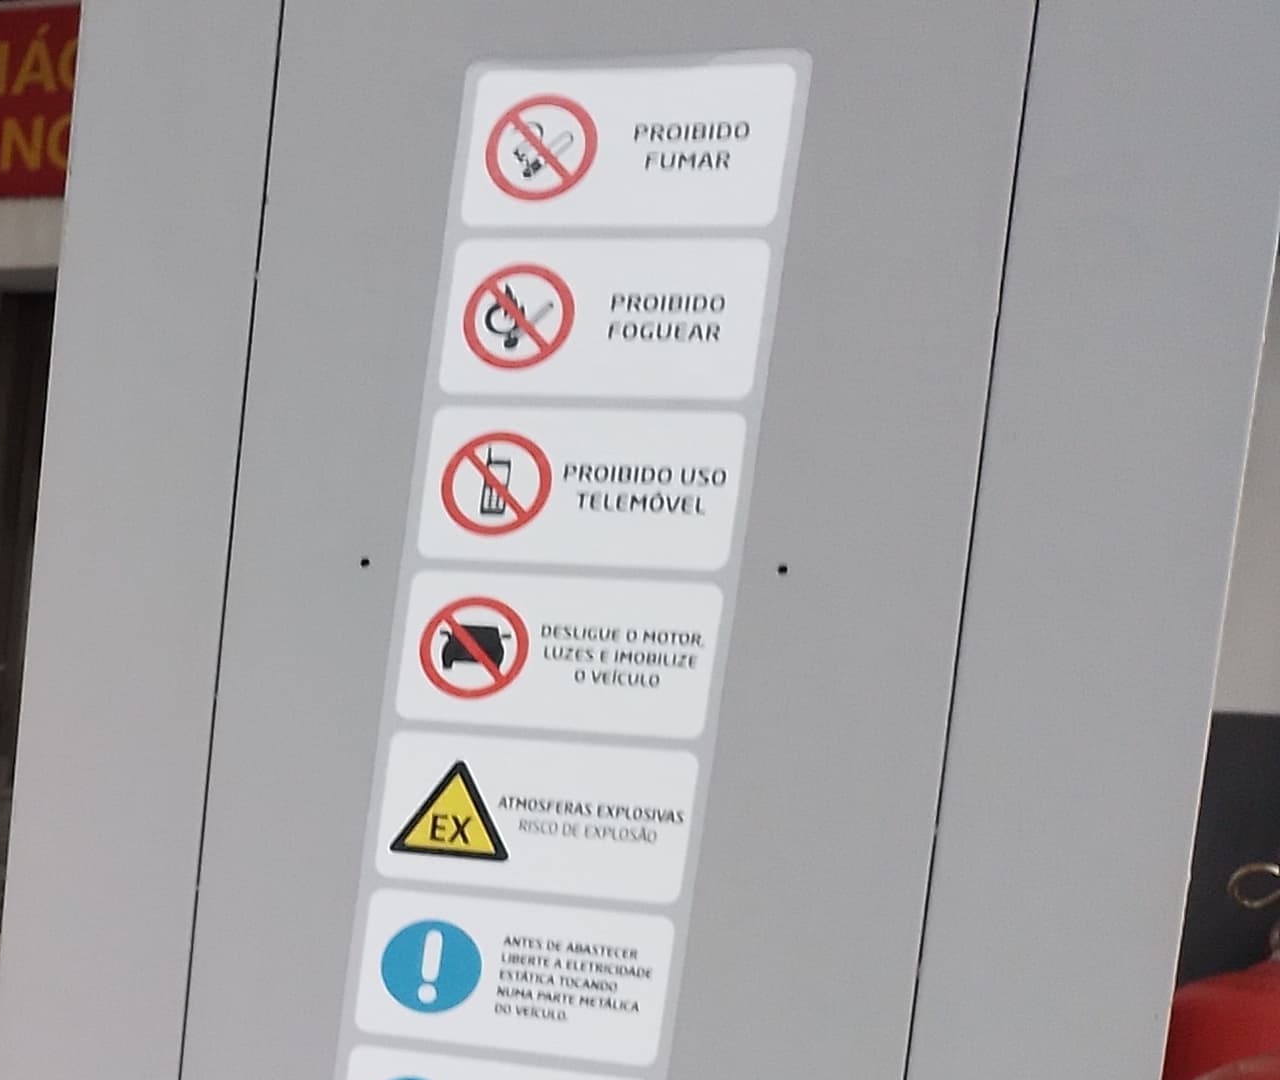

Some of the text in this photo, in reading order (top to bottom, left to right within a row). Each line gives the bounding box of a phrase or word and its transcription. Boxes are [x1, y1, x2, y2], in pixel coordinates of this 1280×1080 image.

[633, 121, 751, 142] PROIBIDO
[644, 151, 731, 170] FUMAR
[610, 293, 726, 313] PROIBIDO
[607, 322, 721, 342] FOGUEAR
[563, 462, 728, 487] PROIBIDO USO
[577, 490, 705, 515] TELEMÓVEL
[540, 623, 621, 642] DESLIGUE
[626, 628, 638, 643] O
[543, 645, 698, 669] LUZES E IMOBILIZE
[574, 668, 661, 688] O VEÍCULO
[498, 796, 685, 824] ATMOSFERAS EXPLOSIVAS
[429, 813, 472, 845] EX
[519, 818, 658, 844] RISCO DE EXPLOSÃO
[504, 935, 638, 961] ANTES DE ABASTECER
[501, 952, 653, 979] LIBERTE A ELETRICIDADE
[559, 975, 618, 992] TOCANDO
[496, 985, 533, 1001] NUMA
[537, 989, 575, 1006] PARTE
[494, 1003, 512, 1016] DO
